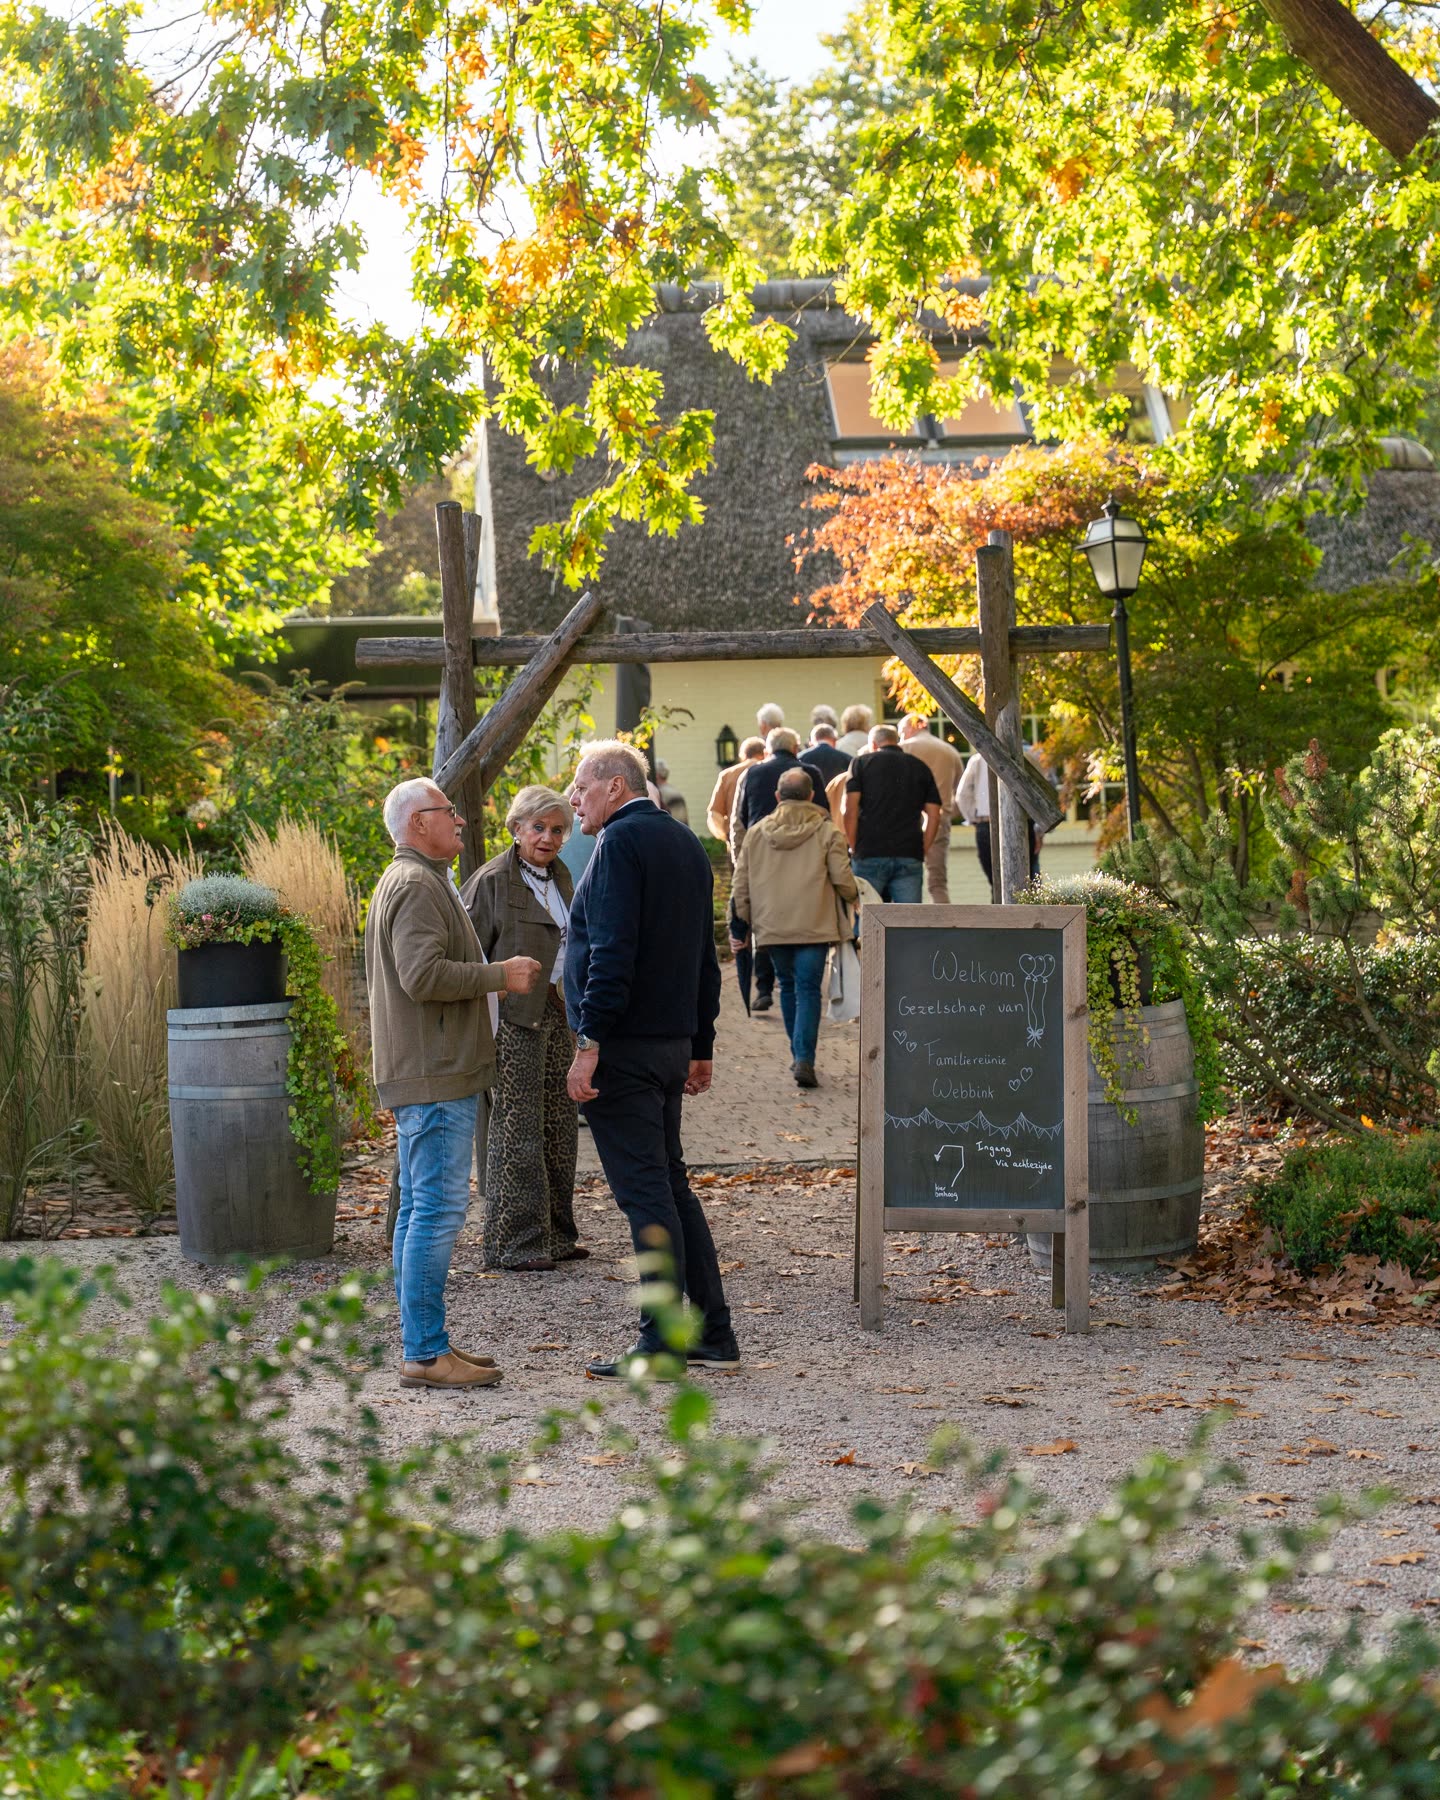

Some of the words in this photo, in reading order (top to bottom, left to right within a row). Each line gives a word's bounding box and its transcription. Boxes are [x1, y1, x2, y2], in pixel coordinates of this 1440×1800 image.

[932, 950, 1015, 988] Welkom
[899, 996, 986, 1016] Gezelschap
[998, 1002, 1024, 1013] van
[924, 1038, 1007, 1066] Familiereünie
[932, 1078, 994, 1099] Webbink
[976, 1140, 1012, 1157] Ingang
[995, 1158, 1009, 1168] Via
[934, 1191, 959, 1202] omhoog
